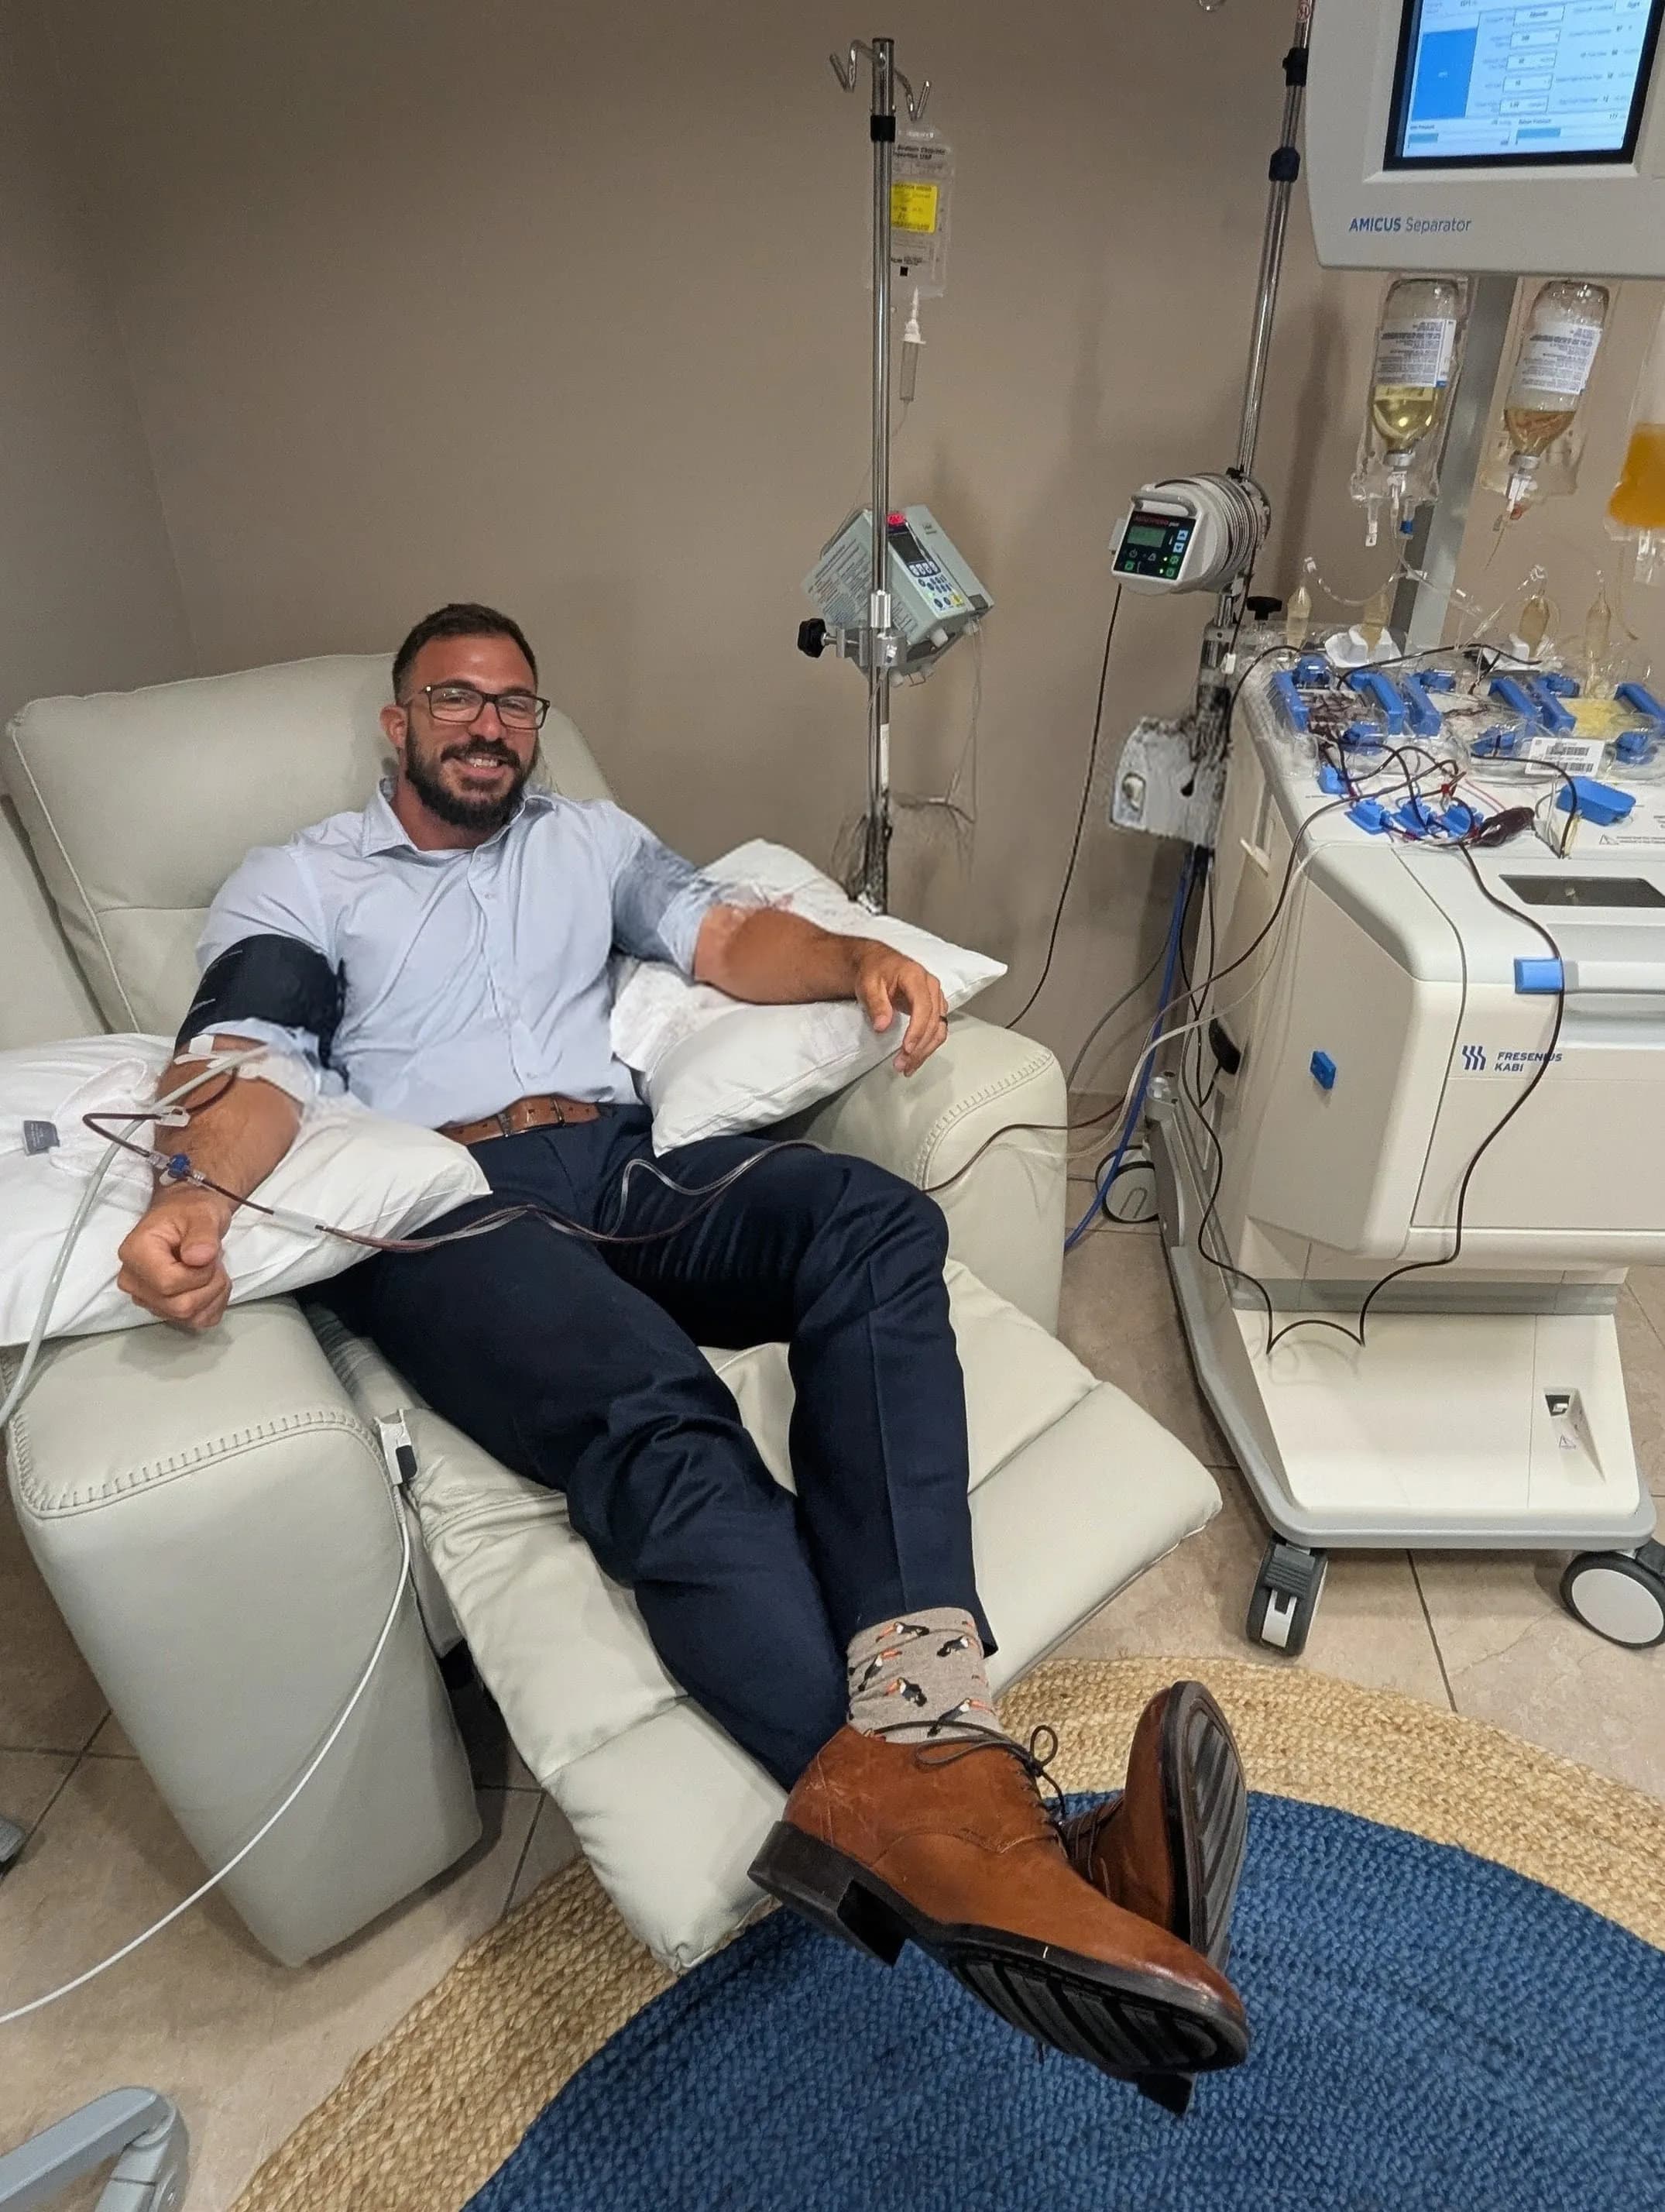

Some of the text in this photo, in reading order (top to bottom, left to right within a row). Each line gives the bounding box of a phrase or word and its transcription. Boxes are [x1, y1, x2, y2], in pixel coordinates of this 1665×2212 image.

[1349, 217, 1471, 234] AMICUS Separator
[1495, 1063, 1524, 1072] KABI
